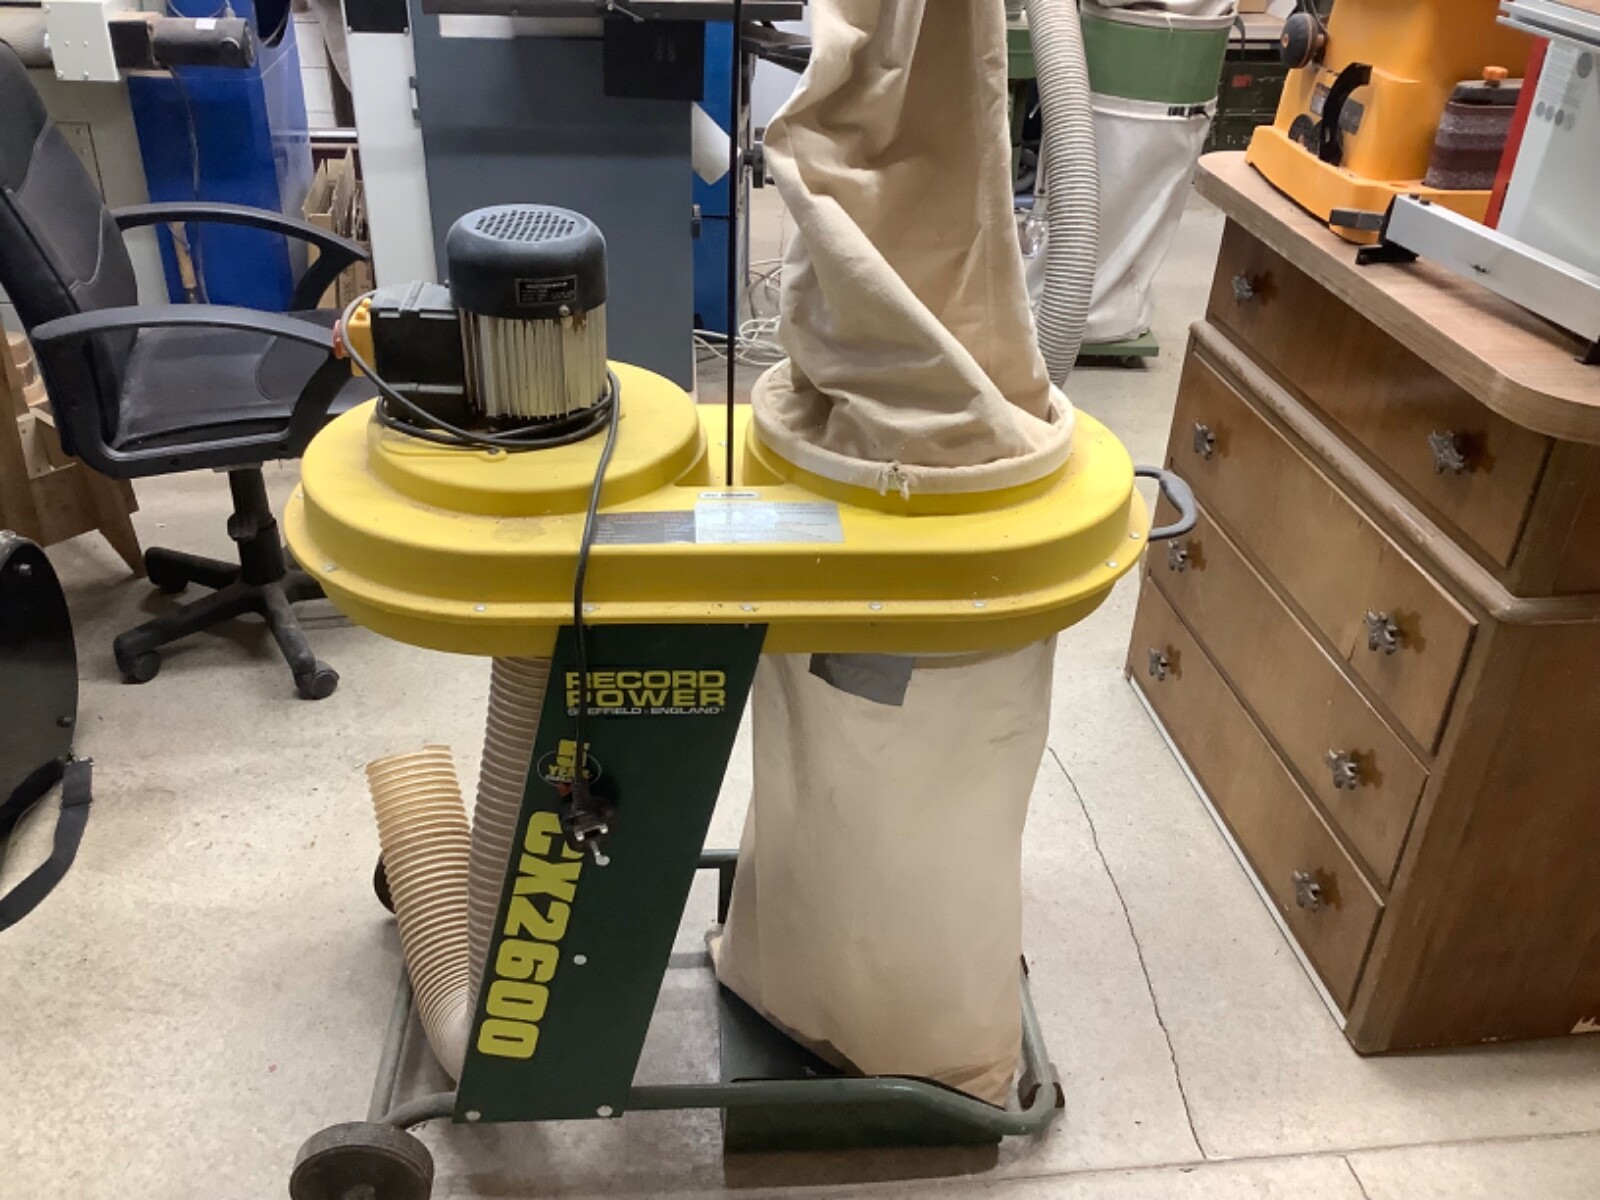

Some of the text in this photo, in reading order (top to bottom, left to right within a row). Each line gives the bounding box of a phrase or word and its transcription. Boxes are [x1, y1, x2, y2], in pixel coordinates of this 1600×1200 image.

[565, 670, 726, 689] RECORD
[565, 689, 726, 707] POWER
[568, 706, 721, 717] SEFFIELD ENGLAND
[476, 810, 585, 1059] CX2600
